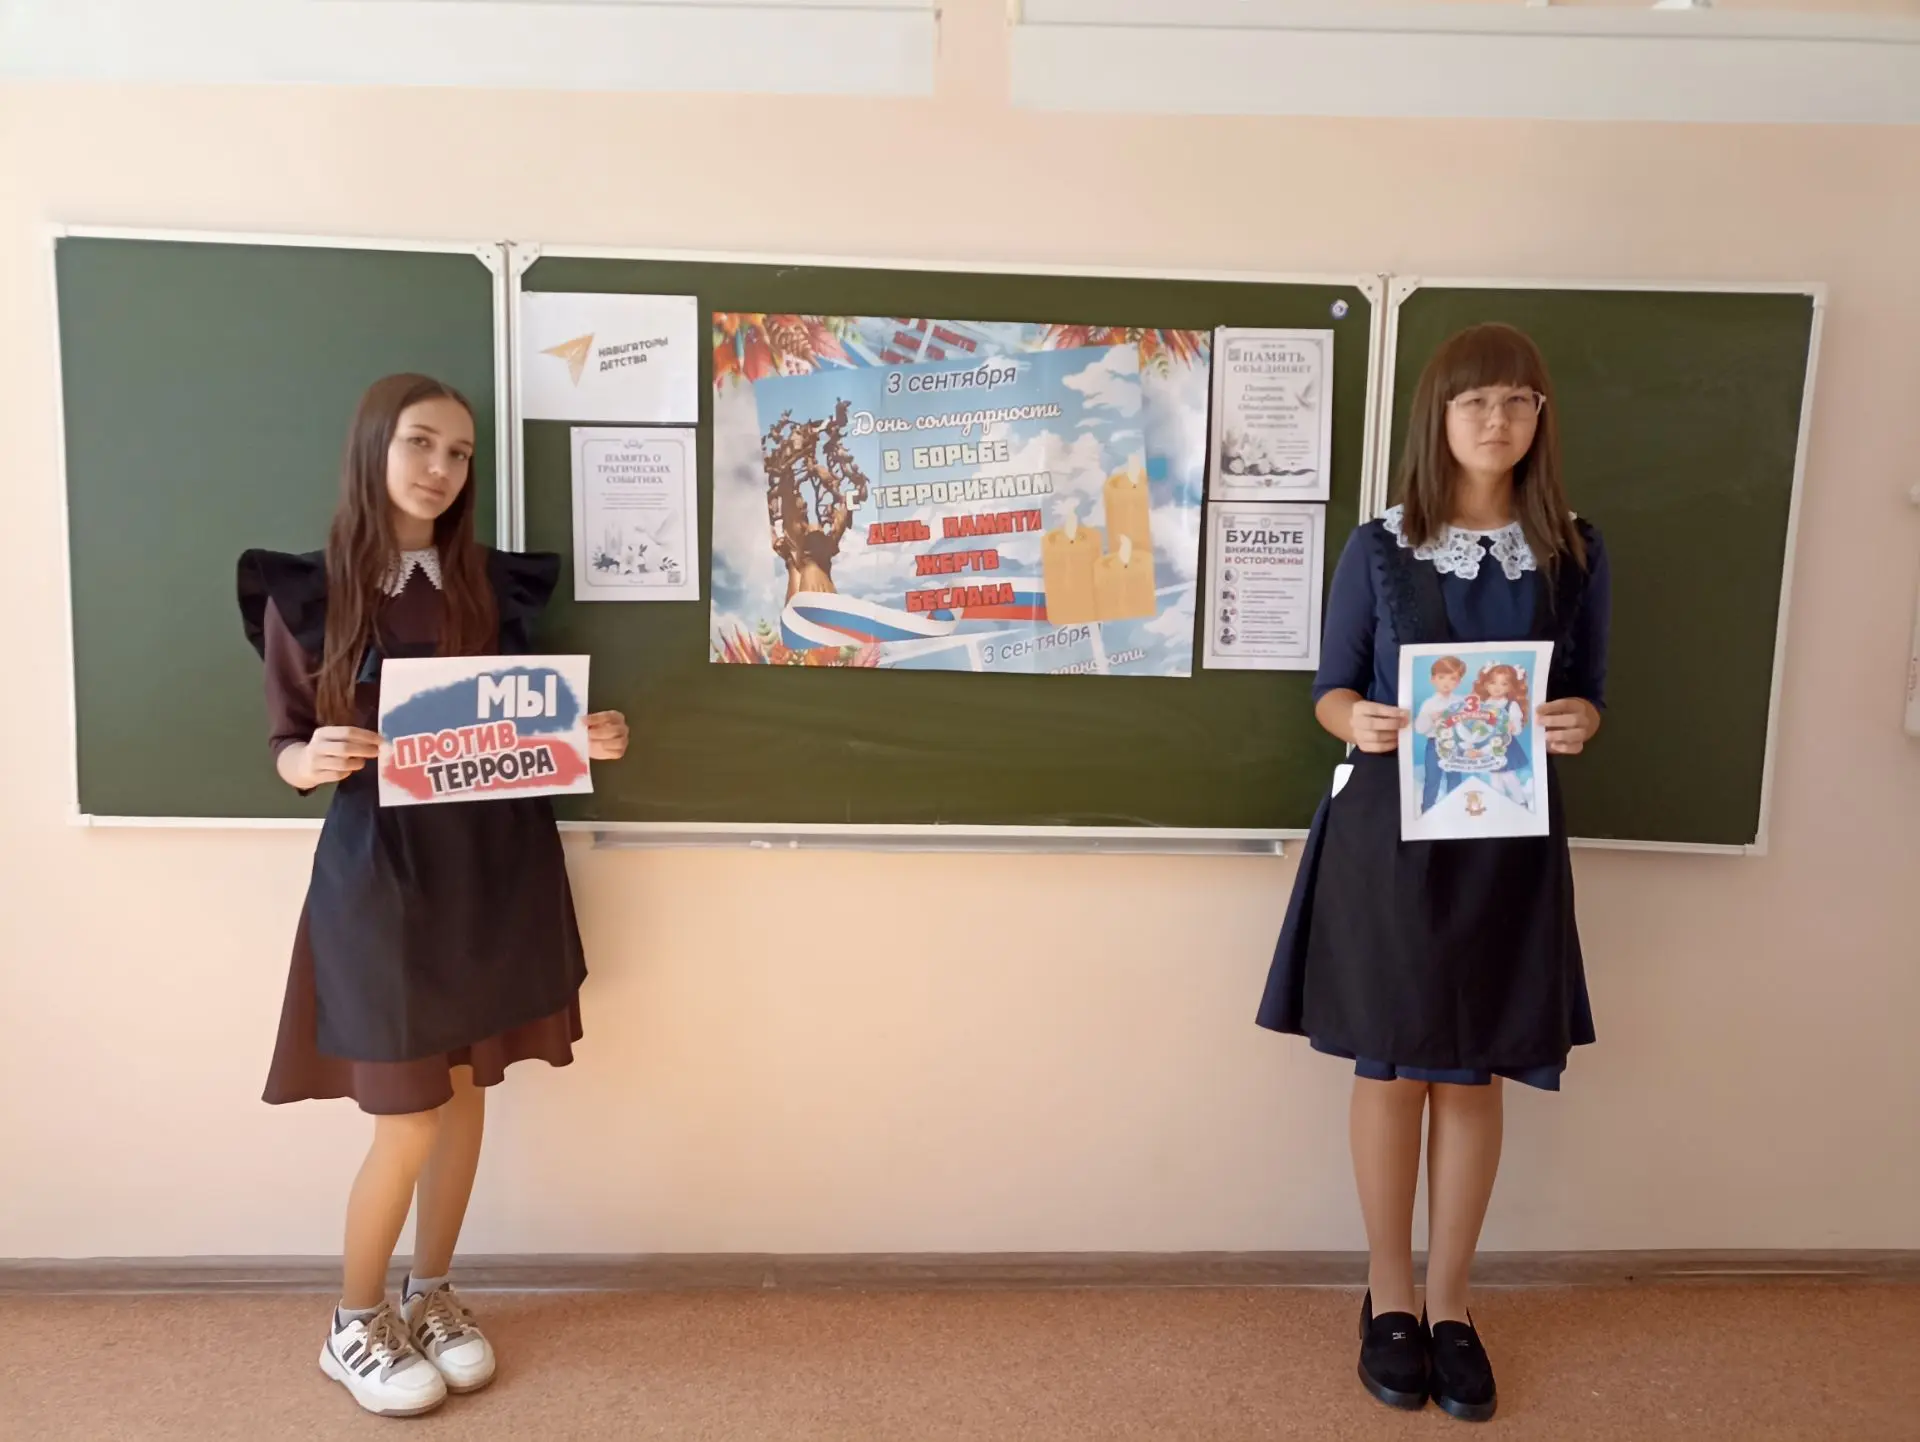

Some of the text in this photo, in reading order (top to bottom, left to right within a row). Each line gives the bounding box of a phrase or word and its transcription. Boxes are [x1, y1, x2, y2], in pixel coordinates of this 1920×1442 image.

[598, 336, 669, 357] НАВИГАТОРЫ
[1243, 351, 1306, 363] ПАМЯТЬ
[599, 353, 648, 372] ДЕТСТВА
[1233, 363, 1312, 374] ОБЪЕДИНЯЕТ
[887, 365, 1017, 394] 3 сентября
[851, 402, 1062, 437] День солидарности
[596, 464, 672, 473] ТРАГИЧЕСКИХ
[604, 453, 662, 463] ПАМЯТЬ О
[882, 439, 1010, 473] В БОРЬБЕ
[605, 475, 664, 484] СОБЫТИЯХ
[846, 471, 1054, 512] С ТЕРРОРИЗМОМ
[866, 508, 1043, 546] ДЕНЬ ПАМЯТИ
[1225, 529, 1305, 545] БУДЬТЕ
[914, 548, 1000, 577] ЖЕРТВ
[1224, 545, 1305, 555] ВНИМАТЕЛЬНЫ
[1224, 555, 1304, 565] И ОСТОРОЖНЫ
[905, 582, 1016, 613] БЕСЛАНА
[983, 624, 1092, 665] 3 сентября
[476, 673, 558, 719] МЫ
[1463, 695, 1480, 713] 3
[395, 721, 517, 767] ПРОТИВ
[426, 747, 555, 793] ТЕРРОРА
